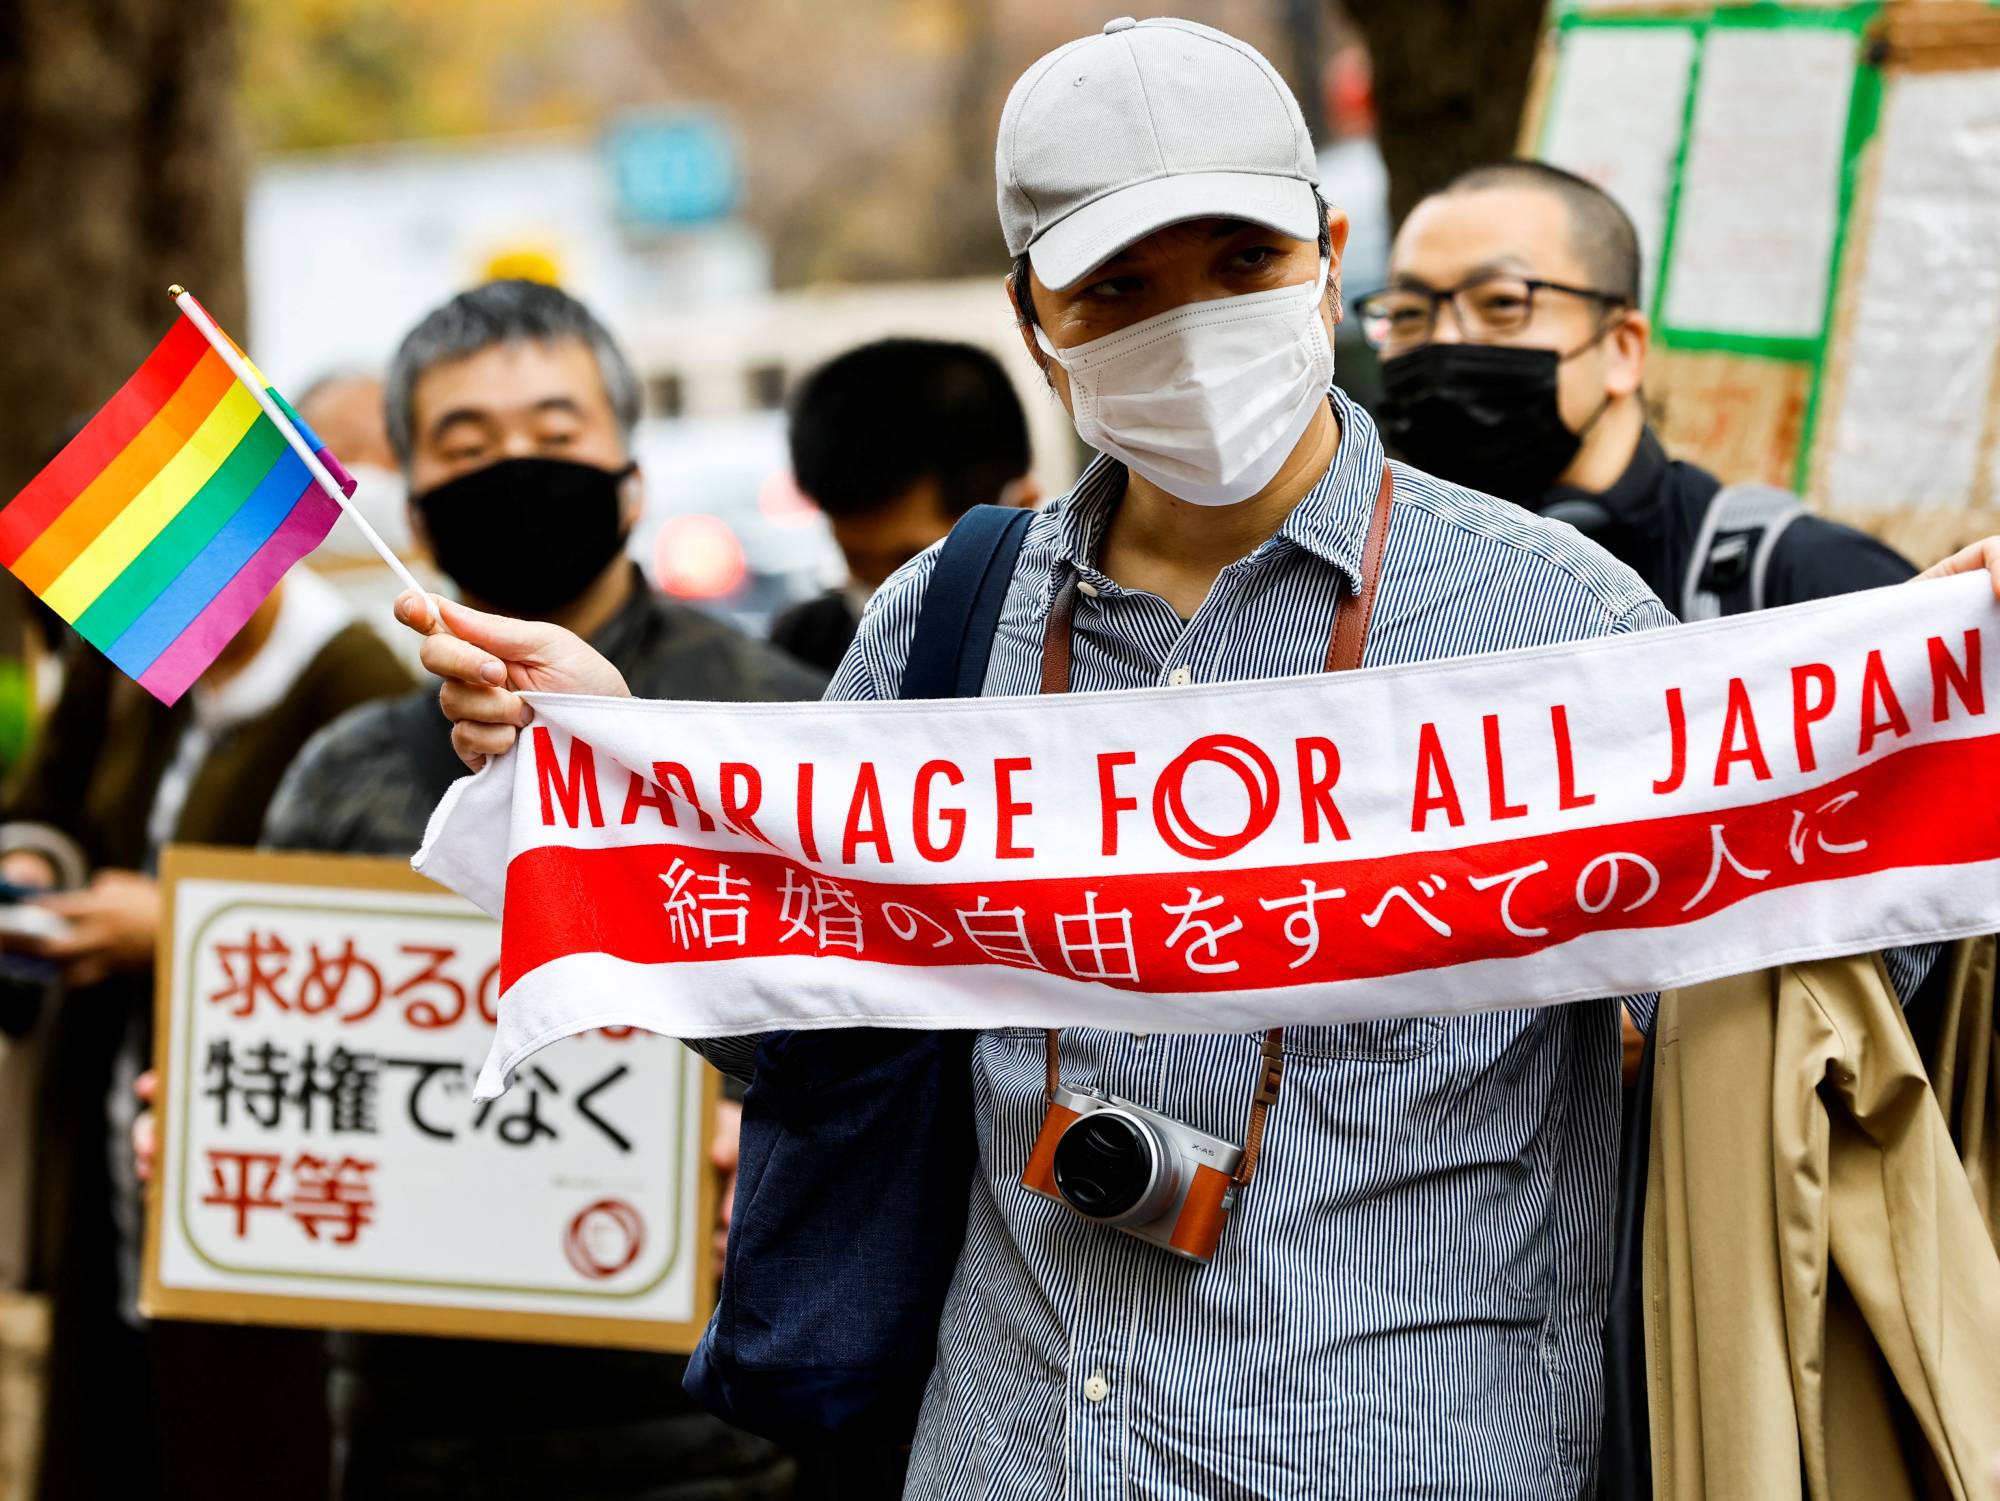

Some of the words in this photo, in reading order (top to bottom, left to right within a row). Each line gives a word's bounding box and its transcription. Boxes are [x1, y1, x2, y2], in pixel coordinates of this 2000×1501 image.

[532, 726, 1036, 865] MARRIAGE
[1096, 732, 1351, 861] FOR
[1411, 703, 1596, 833] ALL
[1652, 627, 1985, 796] JAPAN
[657, 789, 1869, 983] 結婚の自由をすべての人に
[208, 930, 655, 1043] 求める
[203, 1036, 634, 1154] 特権でなく
[202, 1149, 377, 1246] 平等
